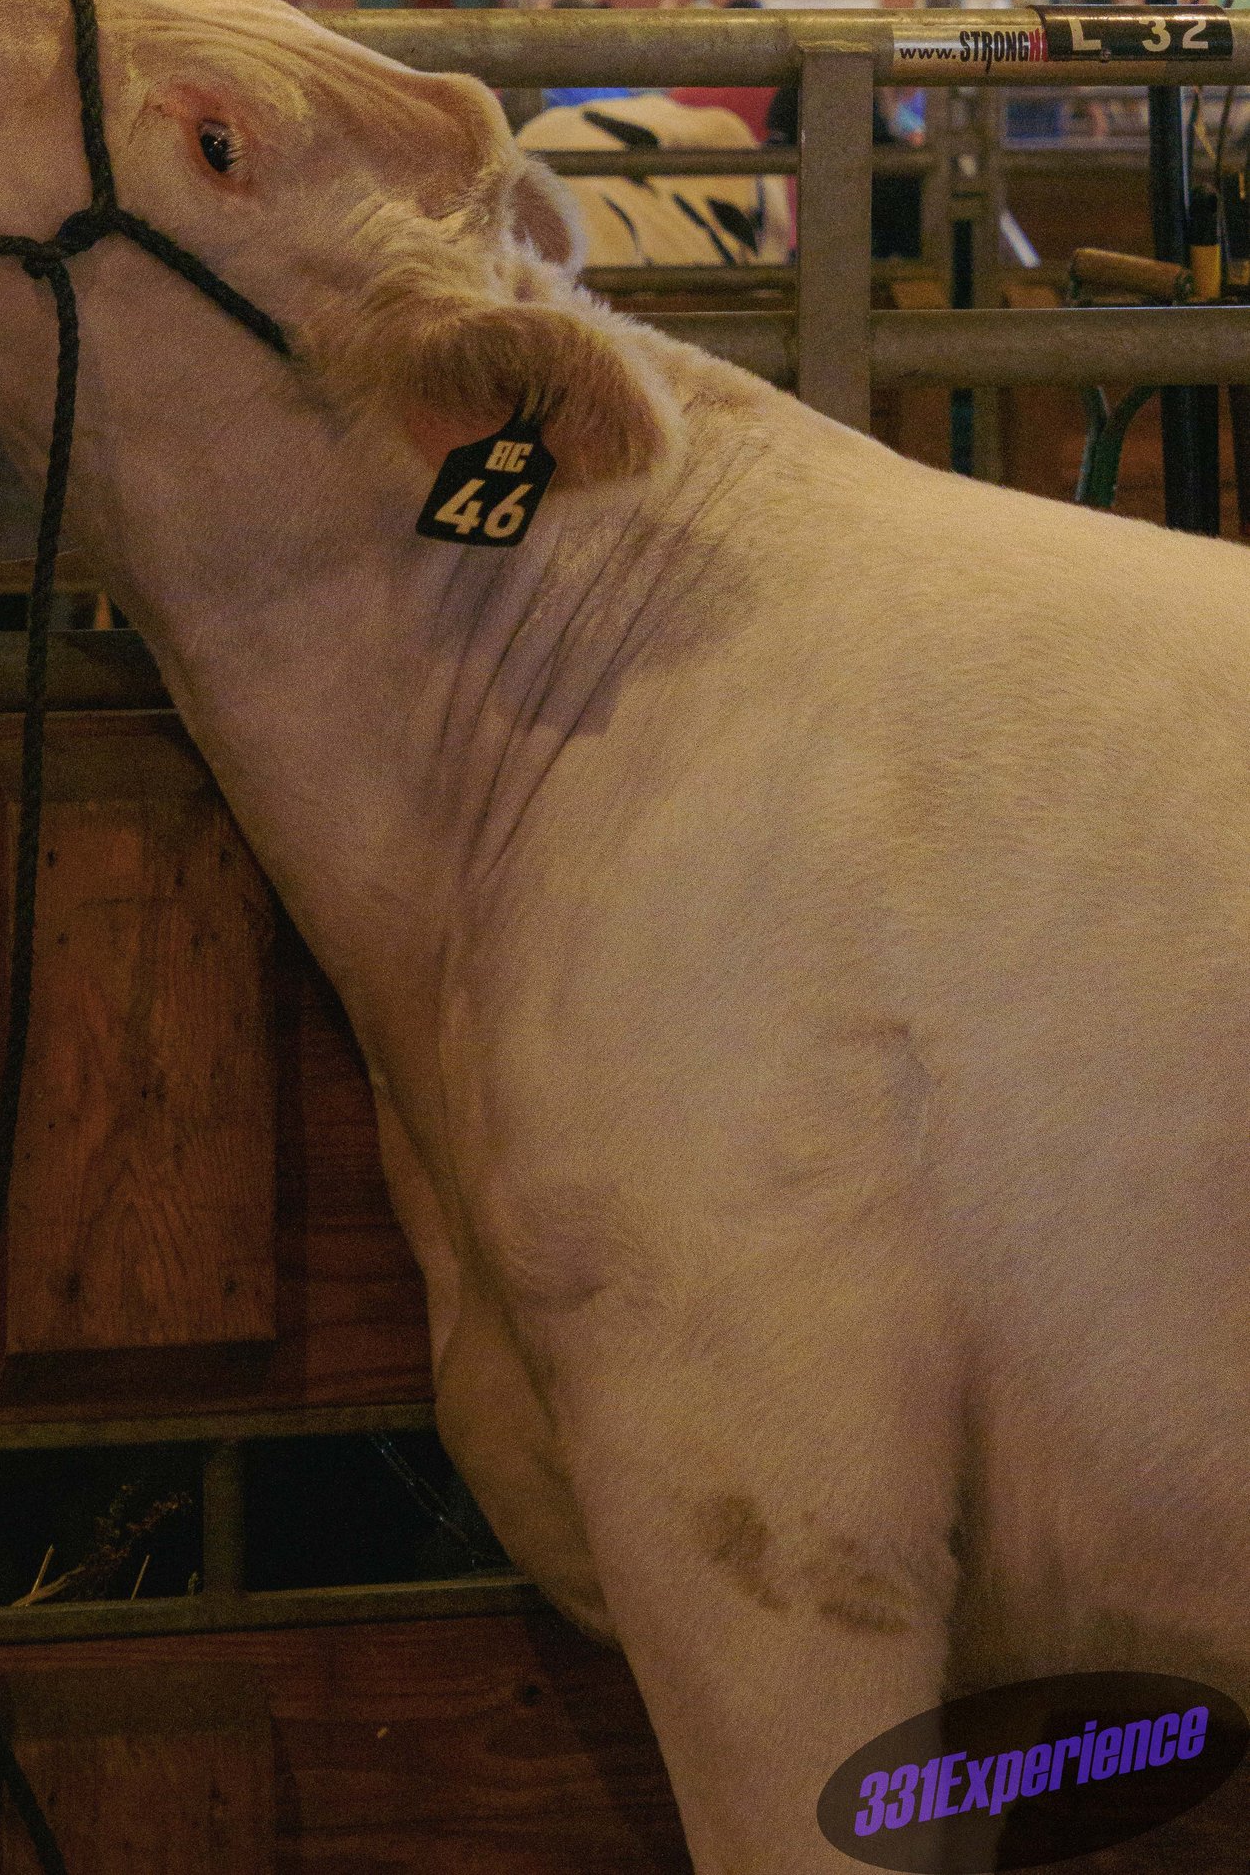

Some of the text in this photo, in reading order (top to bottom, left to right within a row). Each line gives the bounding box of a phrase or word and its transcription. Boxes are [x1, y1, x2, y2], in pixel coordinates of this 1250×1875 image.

[1071, 15, 1209, 52] L 32
[434, 479, 533, 539] 46
